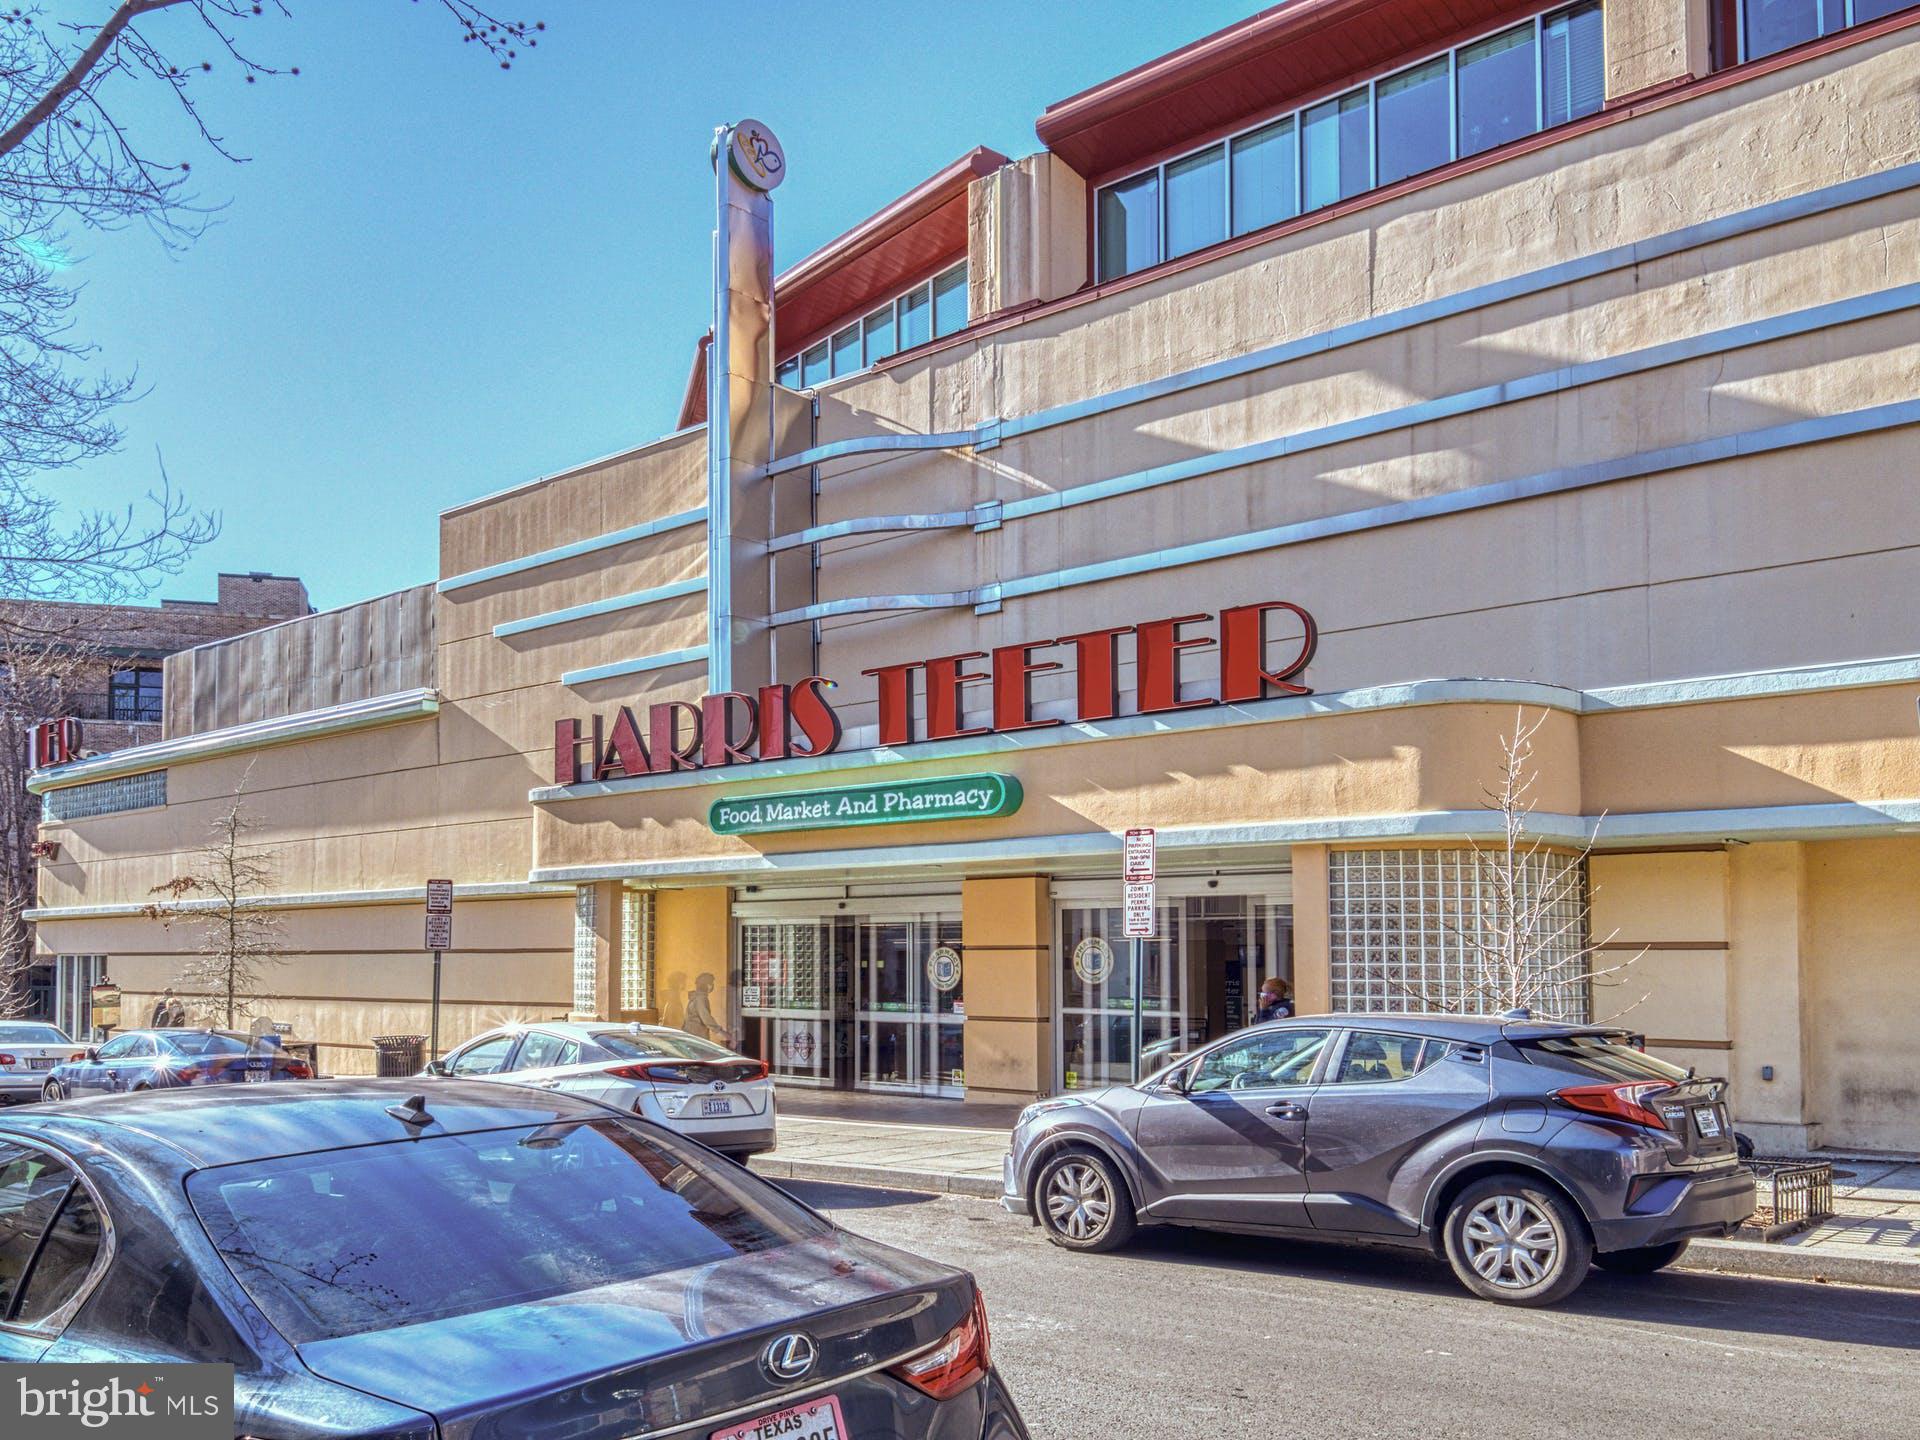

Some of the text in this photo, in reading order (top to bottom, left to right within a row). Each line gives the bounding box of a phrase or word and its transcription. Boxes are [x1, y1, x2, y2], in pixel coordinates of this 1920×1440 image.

[554, 601, 1318, 785] HARRIS TEETER
[719, 788, 994, 826] Food Market And Pharmacy
[754, 1415, 803, 1440] TEXAS
[758, 1409, 796, 1426] DRIVE PINK
